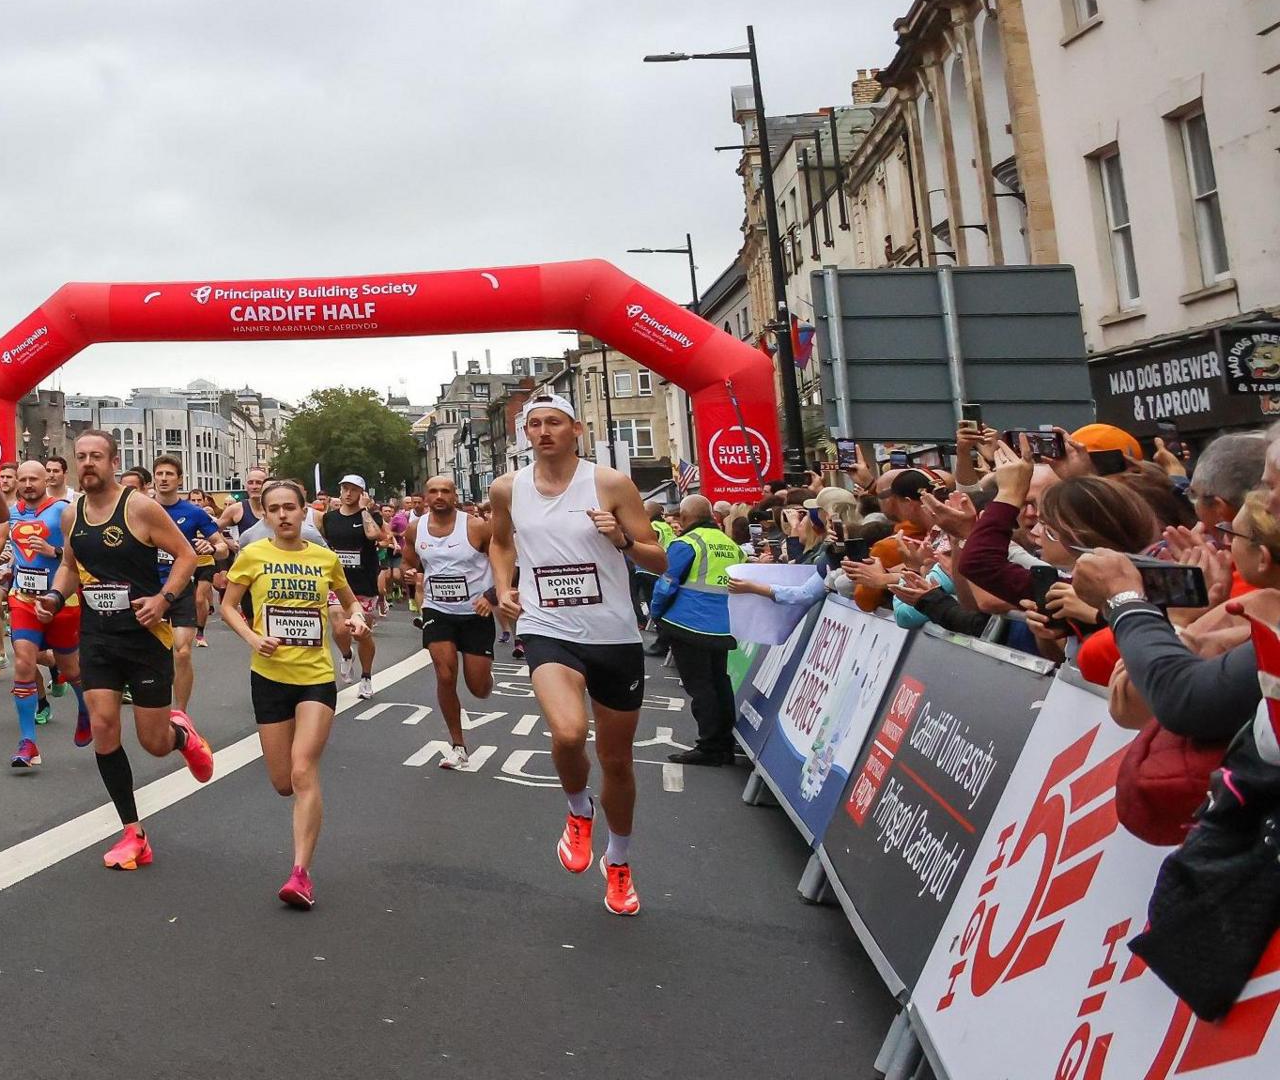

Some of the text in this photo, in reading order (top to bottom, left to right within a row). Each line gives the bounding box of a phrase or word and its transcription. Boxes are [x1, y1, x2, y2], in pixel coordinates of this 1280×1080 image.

[214, 283, 418, 302] Principality Building Society
[230, 303, 376, 322] CARDIFF HALF
[233, 325, 270, 333] HANNER
[273, 324, 326, 332] MARATHON
[640, 313, 693, 348] Principality
[11, 325, 48, 357] Principality
[1231, 338, 1252, 355] DOG
[1109, 370, 1136, 395] MAD
[1136, 363, 1162, 391] DOG
[1133, 387, 1211, 420] & TAPROOM
[719, 445, 760, 454] SUPER
[714, 551, 735, 559] WALES
[264, 563, 322, 577] HANNAH
[271, 578, 317, 591] FINCH
[547, 577, 585, 587] RONNY
[554, 587, 581, 596] 1486
[267, 591, 320, 601] COASTERS
[276, 619, 315, 627] HANNAH
[285, 628, 307, 636] 1072
[806, 617, 853, 681] BRECON
[786, 668, 829, 736] CARREG
[909, 701, 997, 810] Cardiff University
[873, 777, 965, 903] Prifysgol Caerdydd
[937, 822, 1017, 1012] HIGH
[1054, 918, 1132, 1080] HIG
